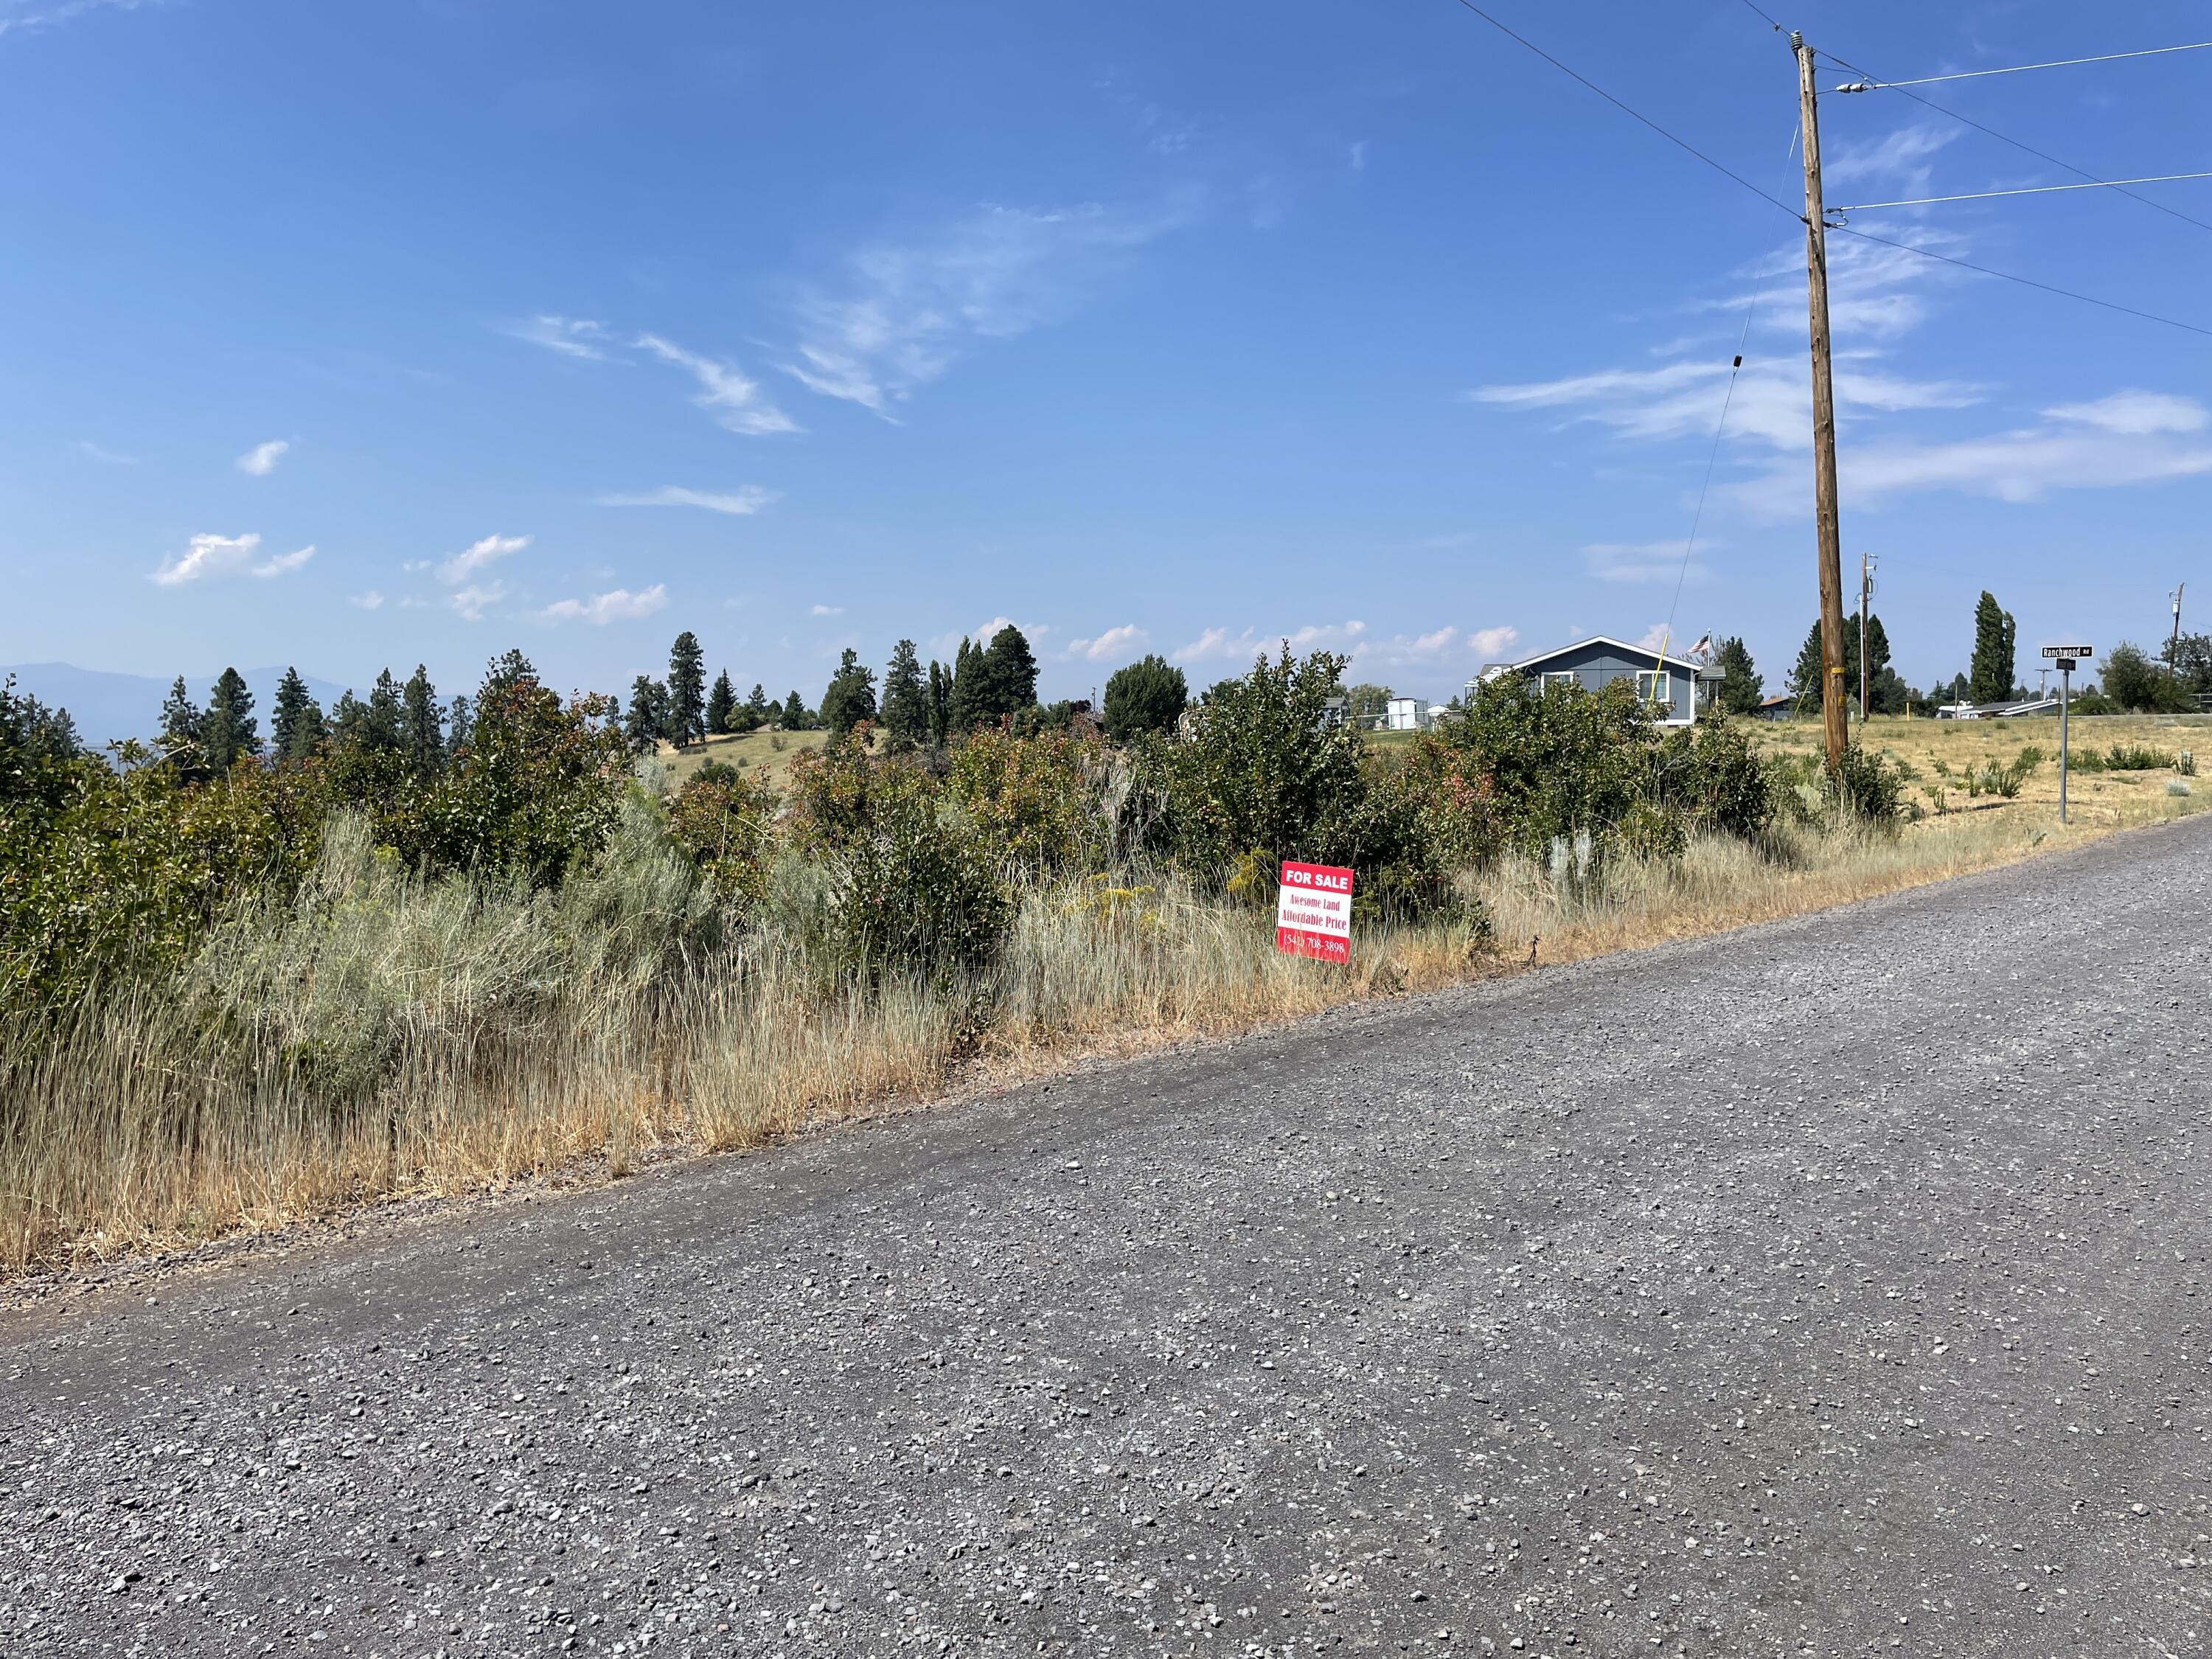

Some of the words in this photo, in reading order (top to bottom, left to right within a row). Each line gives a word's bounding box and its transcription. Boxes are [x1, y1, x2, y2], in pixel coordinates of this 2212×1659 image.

[2043, 647, 2080, 657] Ranchwood
[1286, 870, 1312, 885] FOR
[1315, 874, 1349, 890] SALE
[1290, 894, 1321, 908] Awesome
[1323, 899, 1340, 911] Land
[1281, 909, 1324, 927] Affordable
[1325, 916, 1347, 931] Price
